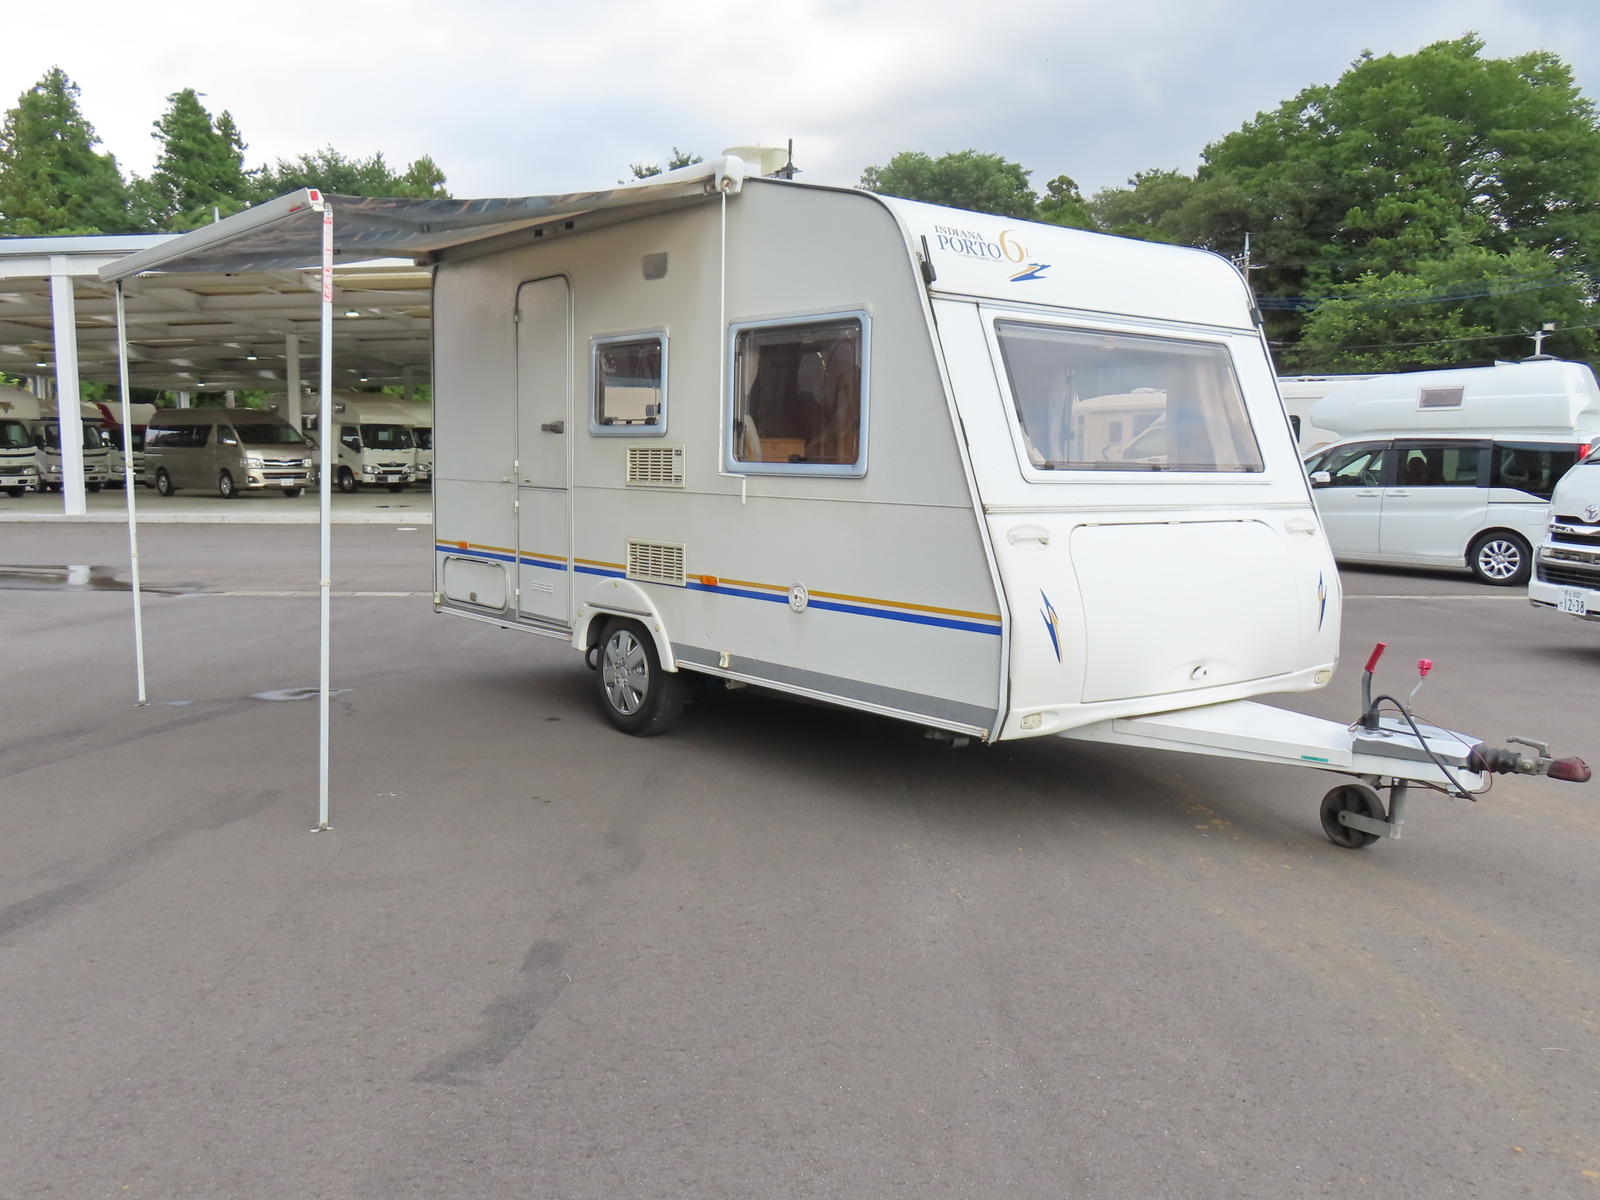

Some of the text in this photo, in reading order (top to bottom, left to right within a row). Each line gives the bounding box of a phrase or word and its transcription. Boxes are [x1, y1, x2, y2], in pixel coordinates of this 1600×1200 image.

[934, 225, 983, 241] INDIANA
[937, 234, 1002, 259] PORTO
[999, 229, 1025, 263] 6
[1564, 598, 1585, 613] 12-38
